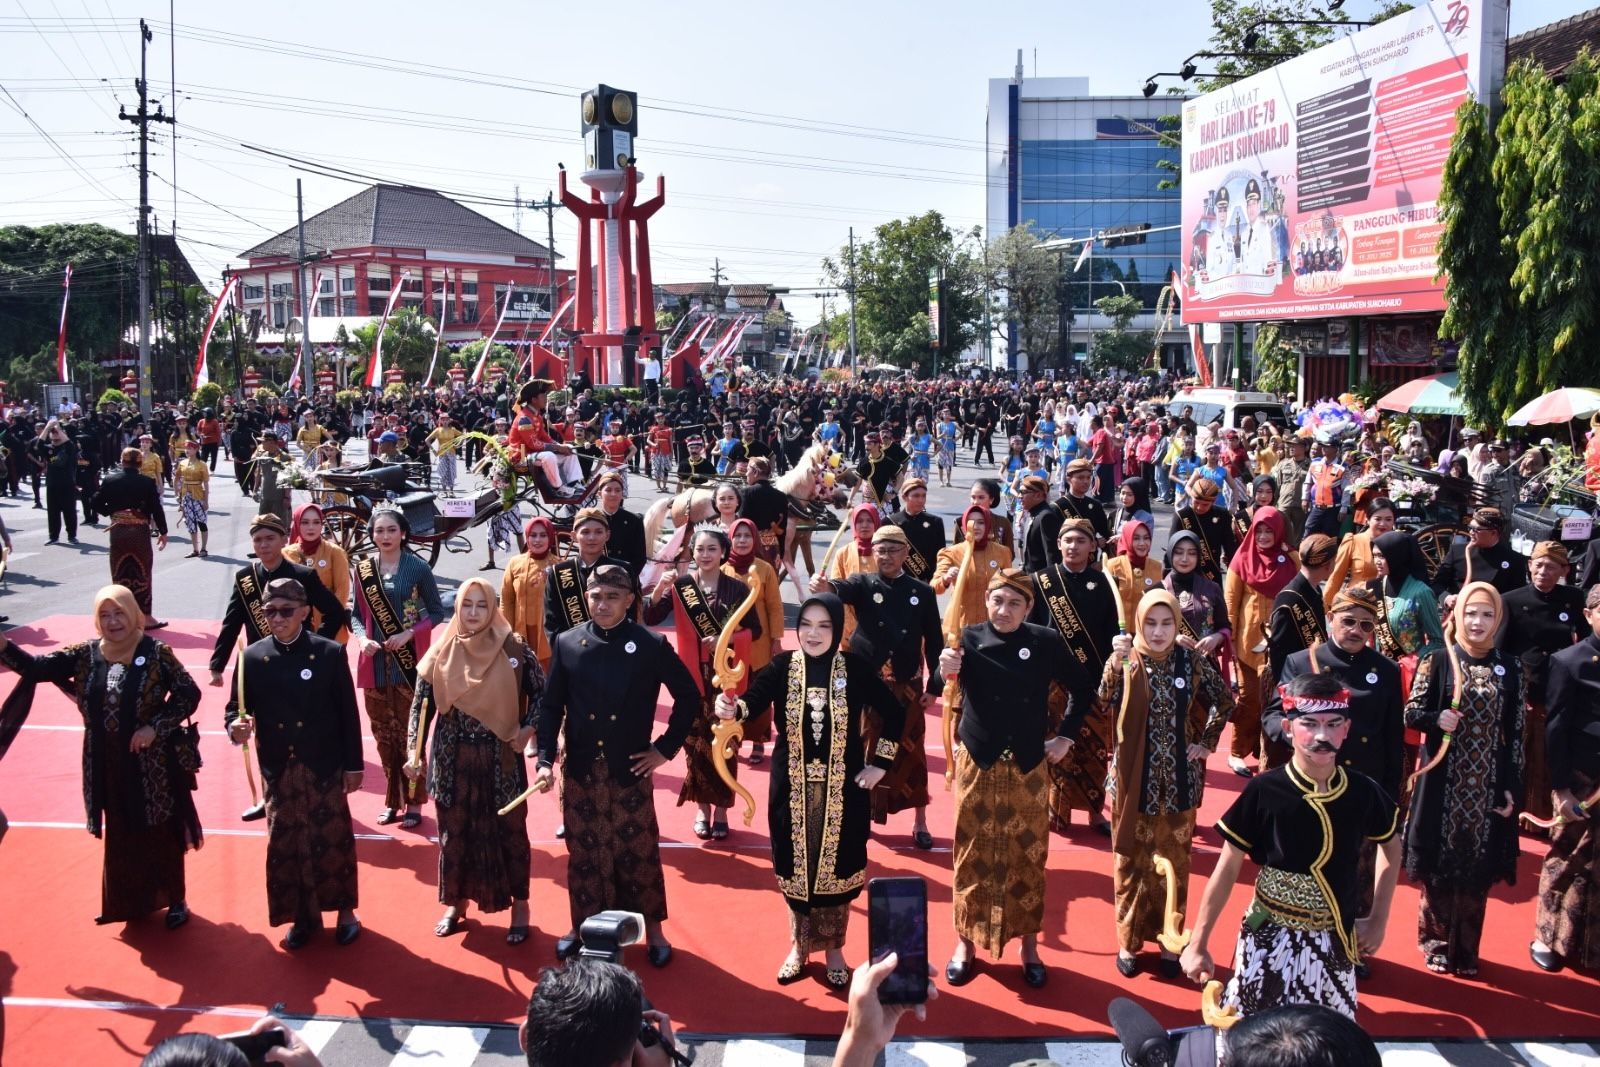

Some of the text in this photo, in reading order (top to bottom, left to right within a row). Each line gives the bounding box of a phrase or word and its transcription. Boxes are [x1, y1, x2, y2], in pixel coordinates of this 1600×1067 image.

[1320, 25, 1435, 75] KEGIATAN PERINGATAN HARI LAHIR KE-79
[1339, 46, 1409, 78] KABUPATEN SUKOHARJO
[1200, 119, 1219, 145] HARI
[1221, 110, 1245, 140] LAHIR
[1247, 98, 1276, 130] KE-79
[1215, 88, 1260, 117] SELAMAT
[1189, 140, 1234, 174] KABUPATEN
[1236, 122, 1290, 161] SUKOHARJO
[1353, 211, 1405, 232] PANGGUNG
[1407, 206, 1440, 223] HIBUR
[359, 558, 374, 581] MBAK
[906, 555, 922, 575] OHARJO
[240, 575, 272, 637] MAS SUKOHAR
[365, 584, 398, 635] SUKOHARJO
[559, 568, 585, 627] MAS SUKOH
[680, 584, 701, 609] MBAK
[1040, 573, 1052, 590] MAS
[1057, 595, 1083, 632] BERBAKAT
[1292, 603, 1304, 621] MAS
[1049, 595, 1075, 639] SUKOHARJO
[1304, 610, 1317, 630] DUTA
